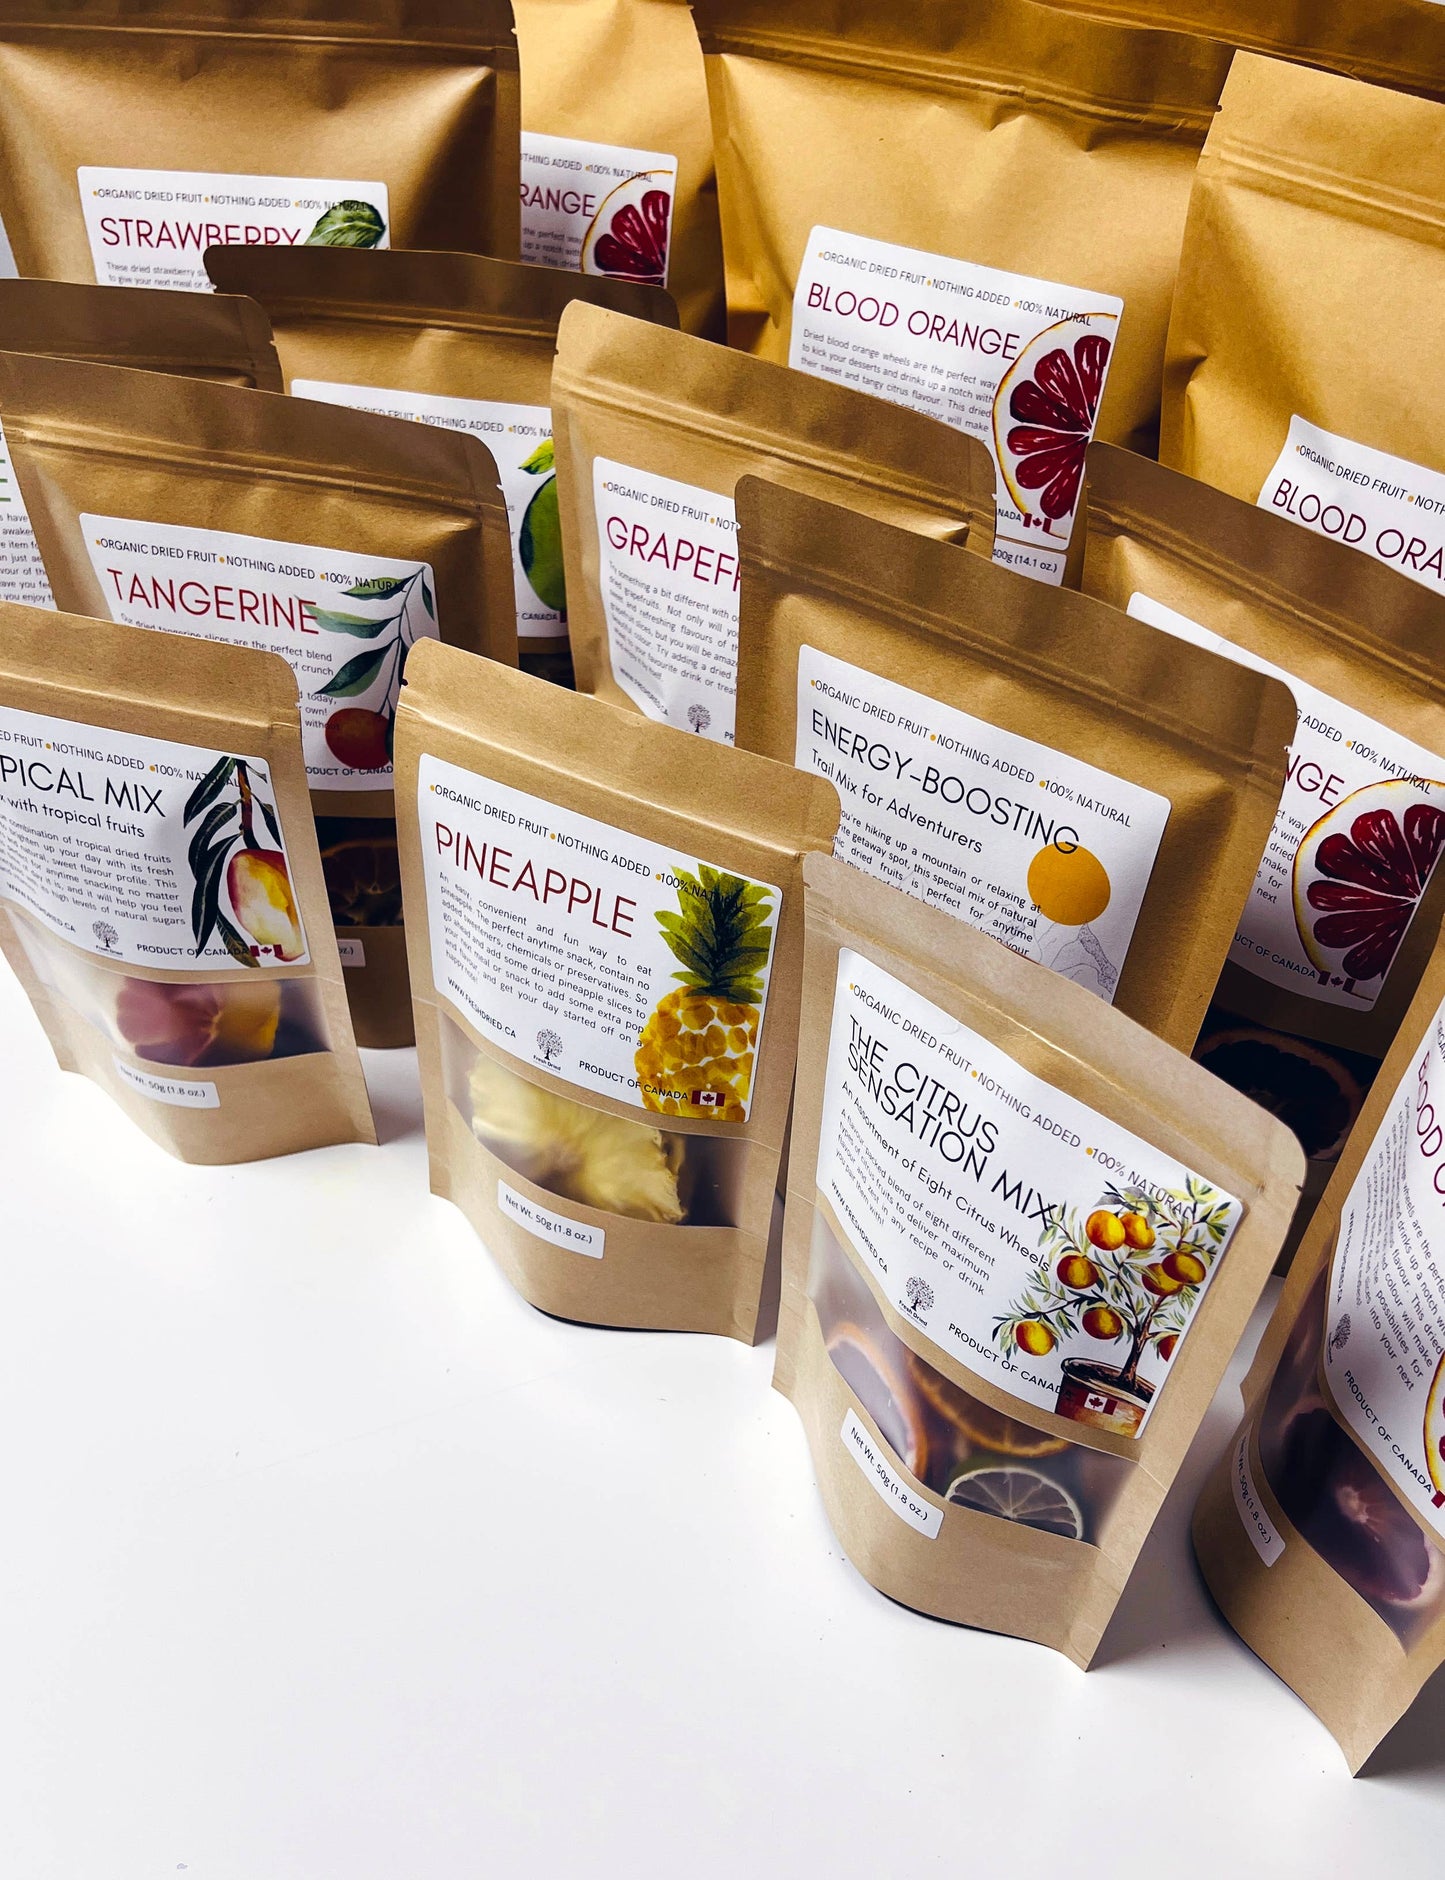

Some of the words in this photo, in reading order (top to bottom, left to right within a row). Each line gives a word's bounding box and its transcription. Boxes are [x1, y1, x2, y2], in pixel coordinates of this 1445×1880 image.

[552, 159, 582, 170] ADDED
[98, 188, 142, 200] ORGANIC
[144, 191, 173, 202] DRIED
[176, 194, 202, 203] FRUIT
[211, 195, 255, 206] NOTHING
[258, 198, 291, 208] ADDED
[299, 200, 322, 210] 100%
[100, 217, 300, 250] STRAWBERRY
[823, 250, 867, 271] ORGANIC
[869, 263, 898, 278] DRIED
[900, 271, 927, 285] FRUIT
[932, 278, 973, 299] NOTHING
[976, 289, 1010, 306] ADDED
[1017, 300, 1043, 314] 100%
[1045, 306, 1092, 327] NATURAL
[807, 282, 899, 327] BLOOD
[908, 310, 1020, 361] ORANGE
[804, 329, 824, 342] Dried
[827, 336, 849, 349] blood
[852, 343, 880, 358] orange
[883, 351, 910, 366] wheels
[946, 371, 976, 386] perfect
[422, 415, 466, 429] NOTHING
[469, 420, 504, 432] ADDED
[512, 425, 537, 436] 100%
[1300, 446, 1334, 472] ORGANIC
[1336, 465, 1370, 486] DRIED
[1371, 480, 1407, 499] FRUIT
[607, 482, 648, 503] ORGANIC
[651, 496, 680, 512] DRIED
[682, 506, 709, 522] FRUIT
[1273, 478, 1366, 543] BLOOD
[1376, 529, 1445, 580] ORA
[100, 538, 148, 553] ORGANIC
[151, 546, 184, 559] DRIED
[187, 551, 218, 563] FRUIT
[226, 556, 275, 573] NOTHING
[278, 564, 315, 580] ADDED
[325, 572, 352, 586] 100%
[1015, 555, 1037, 567] (14.1
[1040, 561, 1057, 573] oz.)
[106, 568, 319, 635] TANGERINE
[521, 613, 557, 621] CANADA
[270, 645, 302, 657] perfect
[306, 649, 332, 662] blend
[302, 663, 334, 676] crunch
[305, 706, 328, 717] own!
[14, 734, 43, 748] FRUIT
[52, 742, 103, 761] NOTHING
[107, 754, 145, 770] ADDED
[154, 763, 183, 778] 100%
[815, 680, 861, 709] ORGANIC
[863, 702, 895, 725] DRIED
[898, 717, 930, 739] FRUIT
[937, 734, 989, 766] NOTHING
[992, 759, 1035, 783] ADDED
[1044, 780, 1073, 801] 100%
[1076, 793, 1131, 827] NATURAL
[1303, 716, 1342, 742] ADDED
[1350, 740, 1377, 763] 100%
[1379, 756, 1431, 794] NATURAL
[105, 777, 166, 817] MIX
[812, 709, 1079, 854] ENERGY-BOOSTING
[812, 748, 833, 780] Trail
[836, 771, 856, 796] Mix
[862, 783, 883, 806] for
[887, 799, 983, 853] Adventurers
[8, 797, 38, 813] with
[42, 804, 101, 827] tropical
[106, 816, 144, 837] fruits
[435, 785, 482, 812] ORGANIC
[484, 804, 516, 825] DRIED
[519, 817, 549, 837] FRUIT
[557, 833, 609, 861] NOTHING
[611, 854, 651, 877] ADDED
[660, 873, 690, 892] 100%
[76, 839, 111, 853] tropical
[115, 847, 139, 859] dried
[144, 853, 171, 864] fruits
[147, 866, 174, 875] fresh
[146, 892, 180, 900] matter
[435, 822, 638, 937] PINEAPPLE
[922, 851, 967, 879] mountain
[986, 881, 1026, 909] relaxing
[137, 944, 184, 955] PRODUCT
[478, 900, 527, 926] convenient
[536, 923, 554, 936] and
[563, 933, 579, 946] fun
[589, 944, 608, 959] way
[636, 964, 652, 976] eat
[492, 921, 524, 941] perfect
[527, 932, 563, 956] anytime
[599, 964, 635, 984] contain
[567, 966, 632, 999] preservatives.
[1255, 945, 1269, 956] OF
[1272, 952, 1316, 978] CANADA
[597, 1006, 622, 1025] extra
[626, 1021, 644, 1034] pop
[579, 1060, 624, 1084] PRODUCT
[627, 1078, 641, 1088] OF
[644, 1084, 688, 1100] CANADA
[849, 1015, 888, 1073] THE
[895, 1062, 999, 1153] CITRUS
[853, 985, 901, 1025] ORGANIC
[902, 1019, 937, 1048] DRIED
[939, 1044, 972, 1072] FRUIT
[978, 1072, 1031, 1118] NOTHING
[1033, 1114, 1081, 1148] ADDED
[1092, 1147, 1126, 1177] 100%
[847, 1044, 988, 1182] SENSATION
[992, 1170, 1058, 1230] MIX
[842, 1081, 854, 1096] An
[854, 1096, 899, 1159] Assortment
[902, 1152, 918, 1171] of
[918, 1167, 952, 1200] Eight
[956, 1196, 995, 1233] Citrus
[1000, 1225, 1050, 1272] Wheels
[505, 1194, 518, 1209] Net
[520, 1206, 533, 1219] Wt.
[536, 1214, 552, 1231] 50g
[554, 1224, 571, 1237] (1.8
[575, 1233, 593, 1244] oz.)
[910, 1232, 939, 1260] recipe
[958, 1269, 985, 1296] drink
[941, 1240, 991, 1281] maximum
[952, 1227, 995, 1266] different
[948, 1323, 999, 1361] PRODUCT
[1001, 1360, 1018, 1375] OF
[1413, 1335, 1432, 1367] make
[1397, 1364, 1414, 1391] next
[1344, 1370, 1379, 1424] PRODUCT
[1377, 1426, 1392, 1442] OF
[1391, 1444, 1432, 1493] CANADA
[851, 1427, 863, 1449] Net
[864, 1446, 874, 1466] Wt.
[876, 1464, 890, 1487] 50g
[891, 1484, 907, 1504] (1.8
[909, 1503, 928, 1520] oz.)
